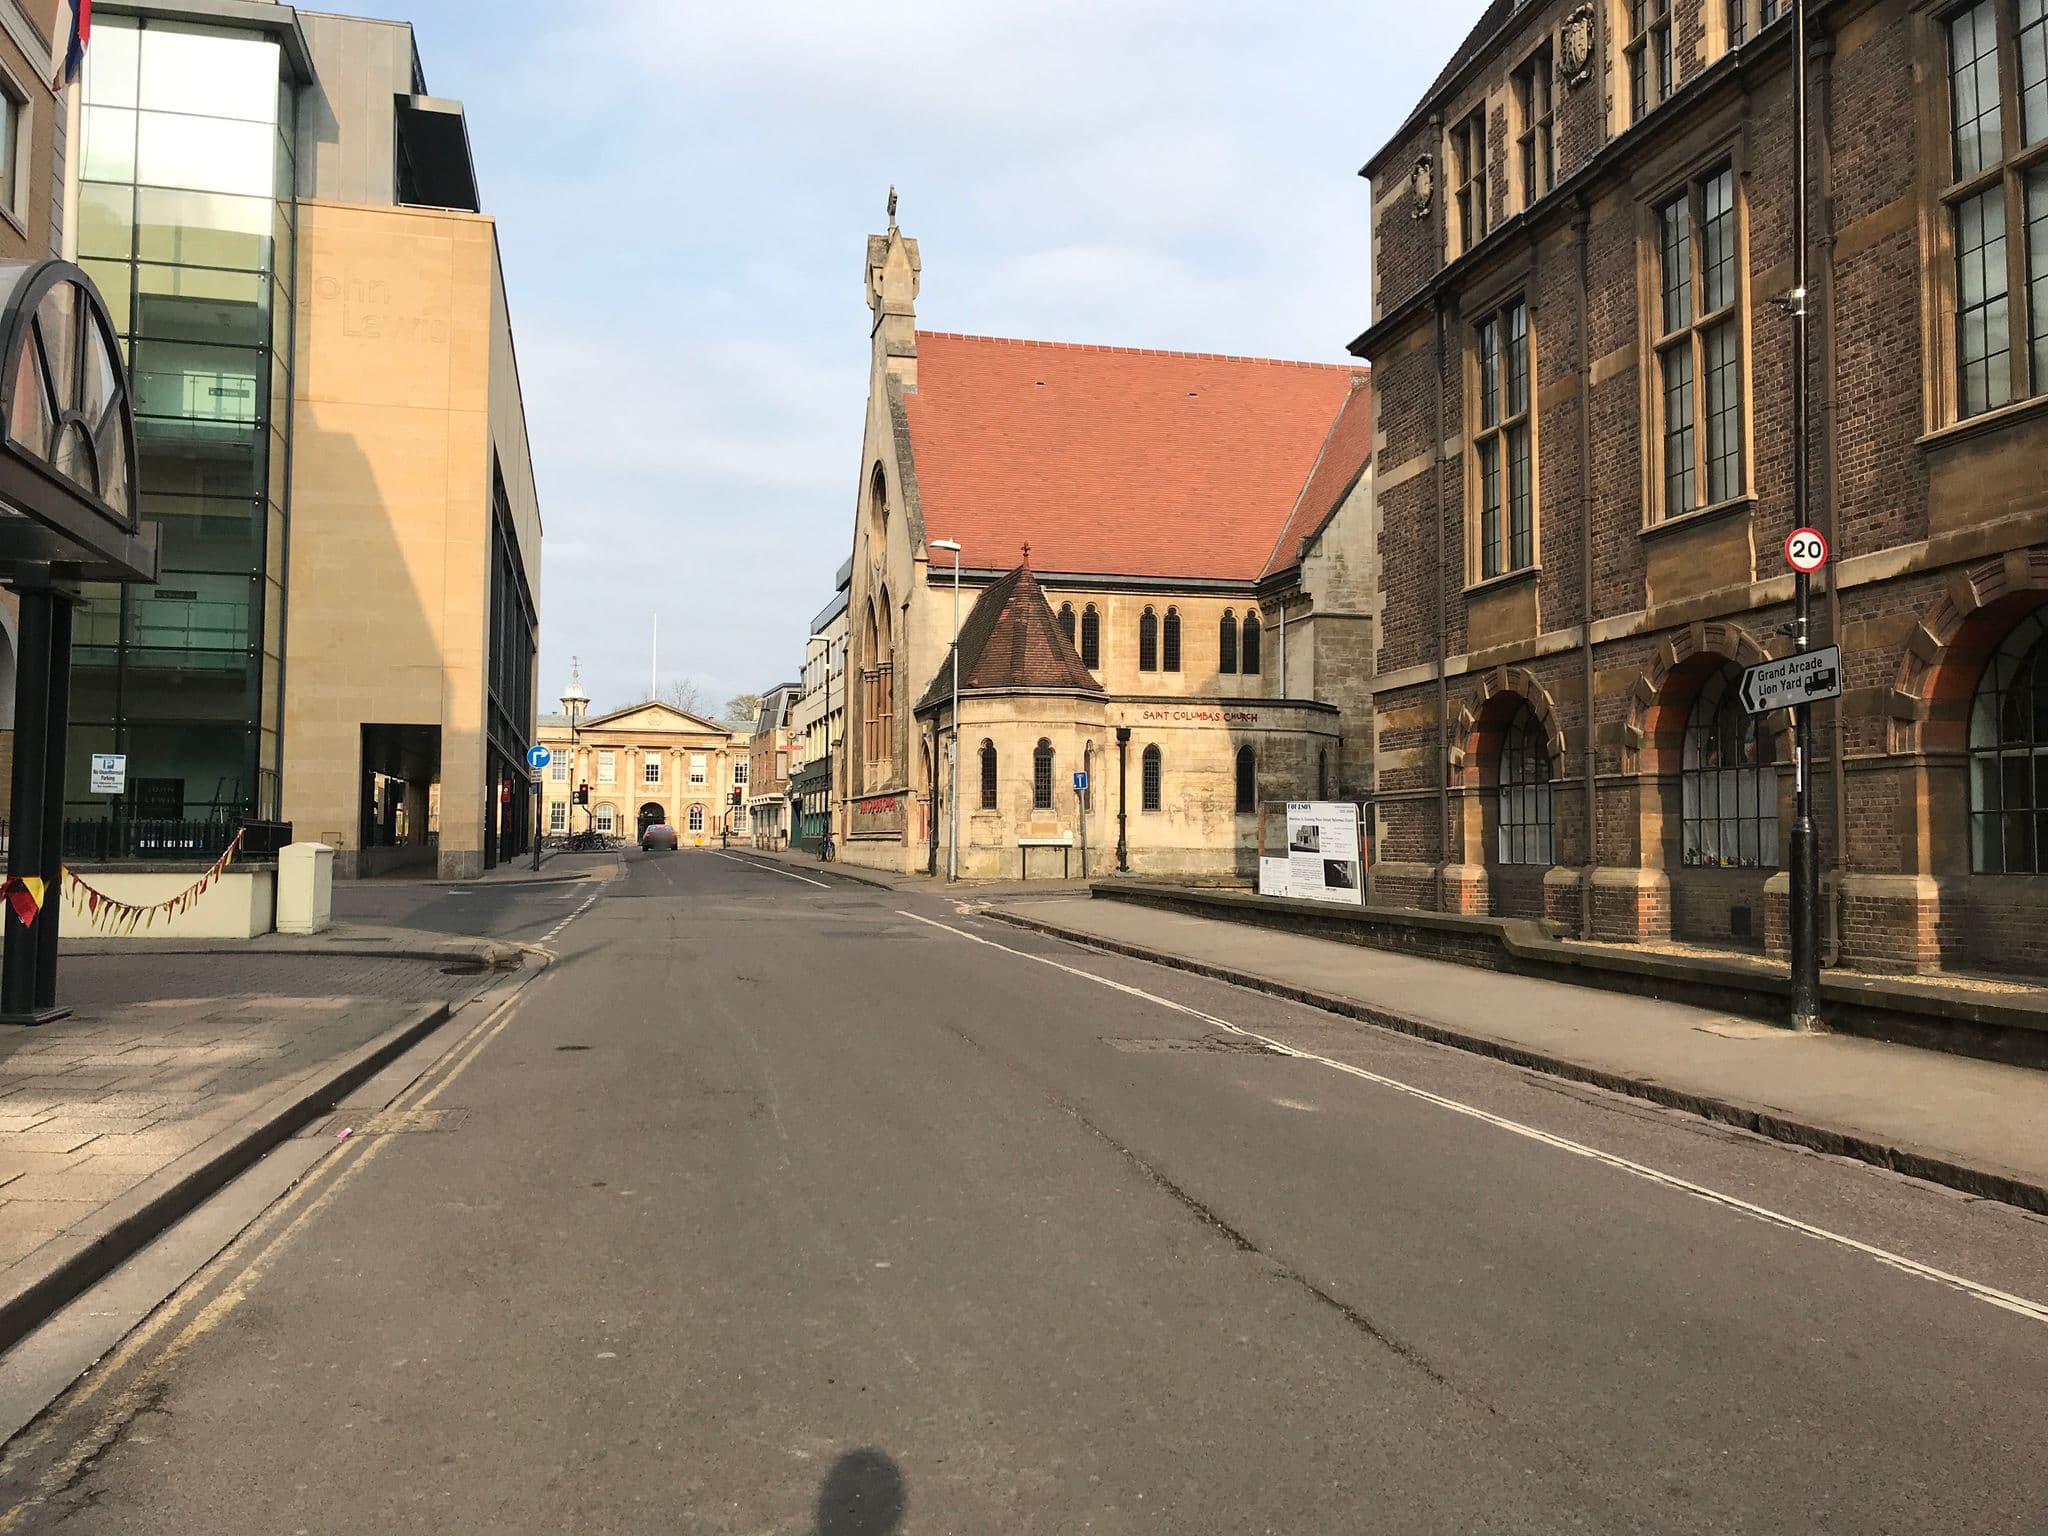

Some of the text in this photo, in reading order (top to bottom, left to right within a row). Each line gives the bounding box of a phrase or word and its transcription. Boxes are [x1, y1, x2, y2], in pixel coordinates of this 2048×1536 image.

[1793, 540, 1821, 558] 20
[1758, 657, 1823, 681] Grand Arcade
[1759, 677, 1802, 696] Lion Yard
[1143, 710, 1169, 720] SAINT
[1223, 712, 1258, 722] CHURCH
